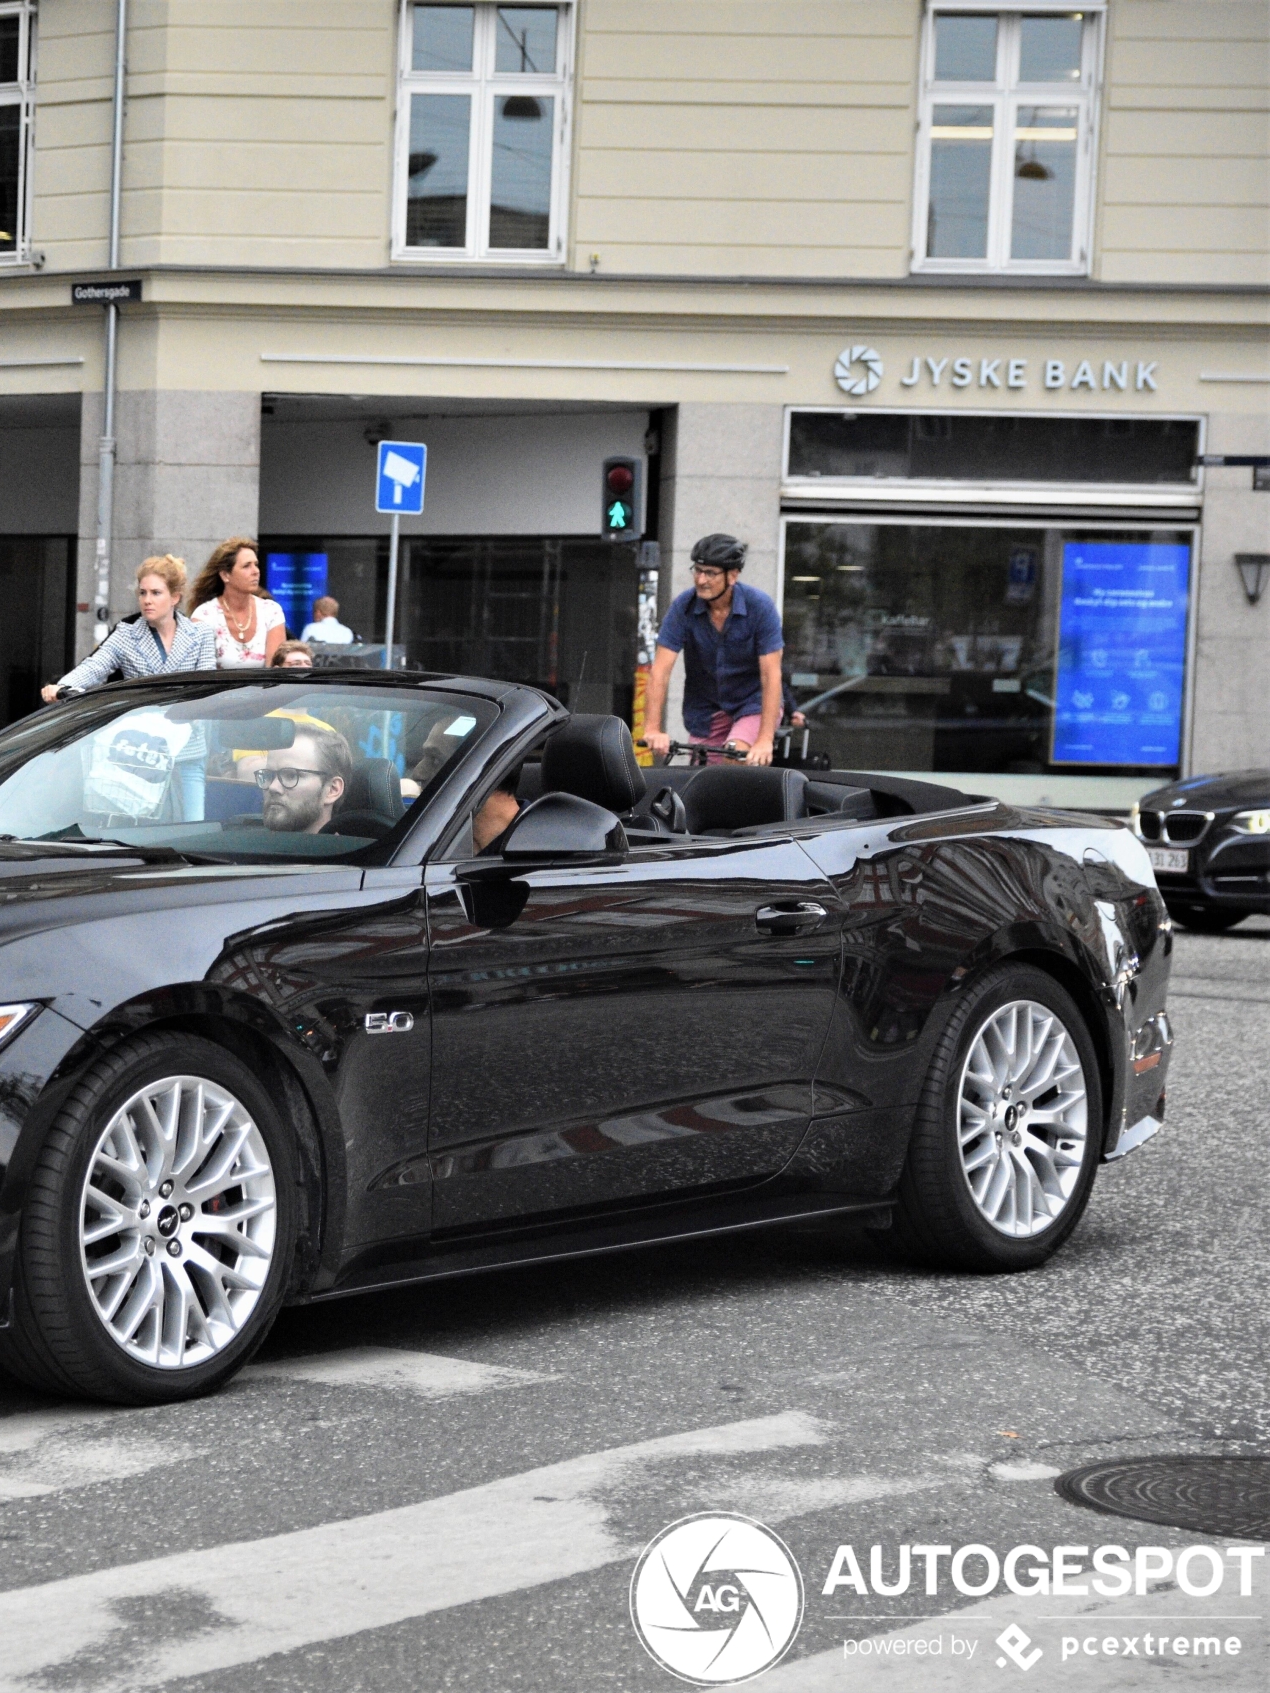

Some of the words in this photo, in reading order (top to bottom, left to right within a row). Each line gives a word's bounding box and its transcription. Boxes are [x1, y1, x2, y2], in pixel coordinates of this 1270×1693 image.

[74, 284, 130, 300] Gothersgade
[901, 356, 1029, 389] JYSKE
[1044, 359, 1160, 391] BANK
[365, 1011, 414, 1034] 5.0
